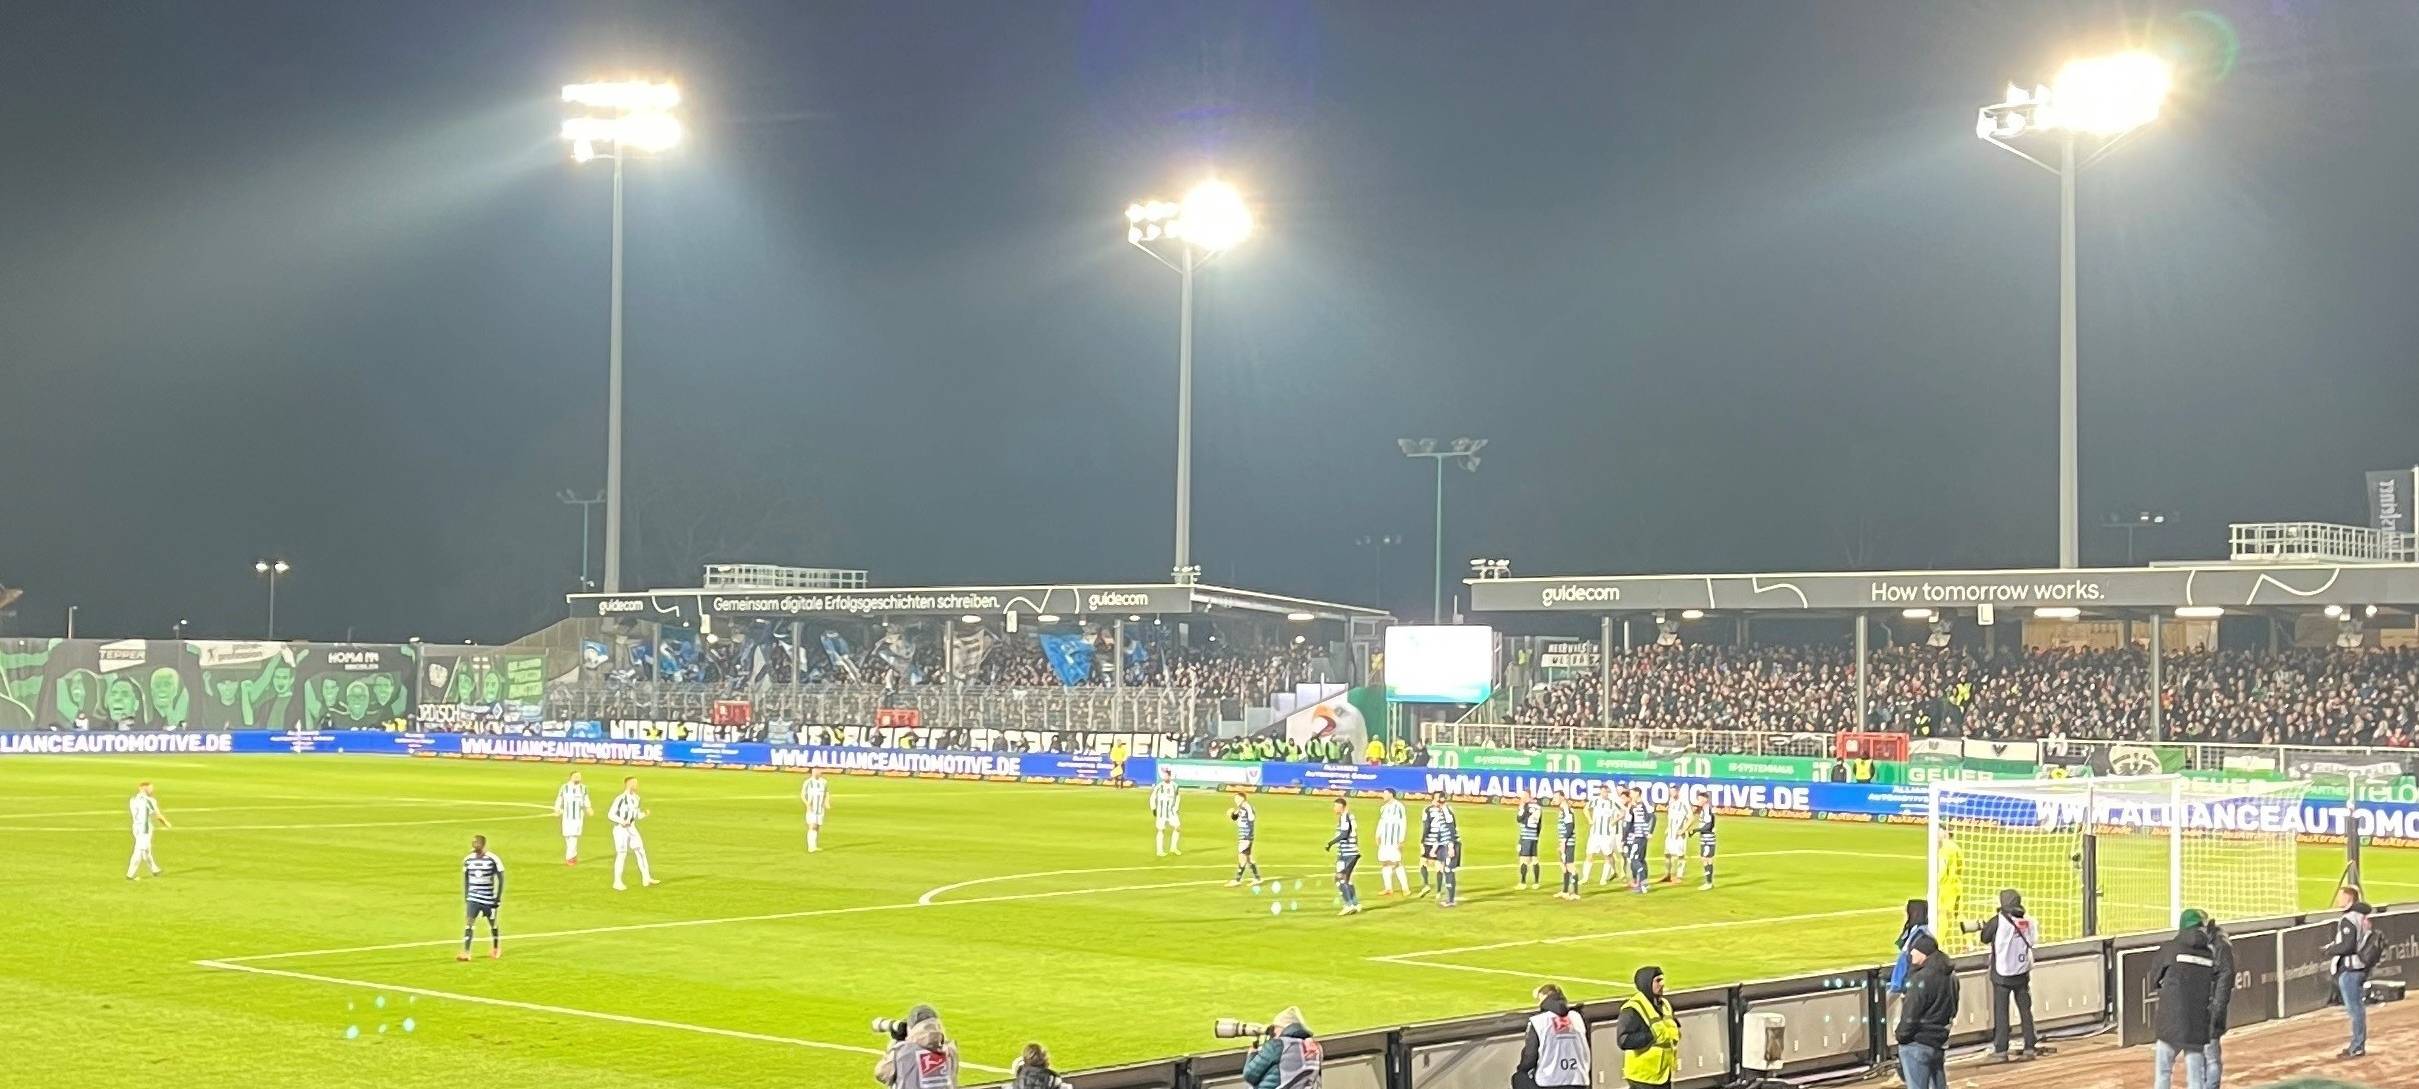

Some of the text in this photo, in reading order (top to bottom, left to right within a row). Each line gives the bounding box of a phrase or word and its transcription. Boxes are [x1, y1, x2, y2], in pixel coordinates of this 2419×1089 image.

[1089, 591, 1148, 611] guidecom
[1542, 584, 1620, 607] guidecom
[1871, 579, 2105, 601] How tomorrow works.
[599, 598, 643, 615] guidecom
[713, 593, 1001, 614] Gemeinsam digitale Erfolgsgeschichten schreiben.
[461, 738, 663, 761] WWW.ALLIANCEAUTOMOTIVE.DE
[771, 749, 1021, 776] WWW.ALLIANCEAUTOMOTIVE.DE
[1425, 774, 1809, 810] WWW.ALLIANCEATOMOTIVE.DE
[1560, 1058, 1578, 1070] 02
